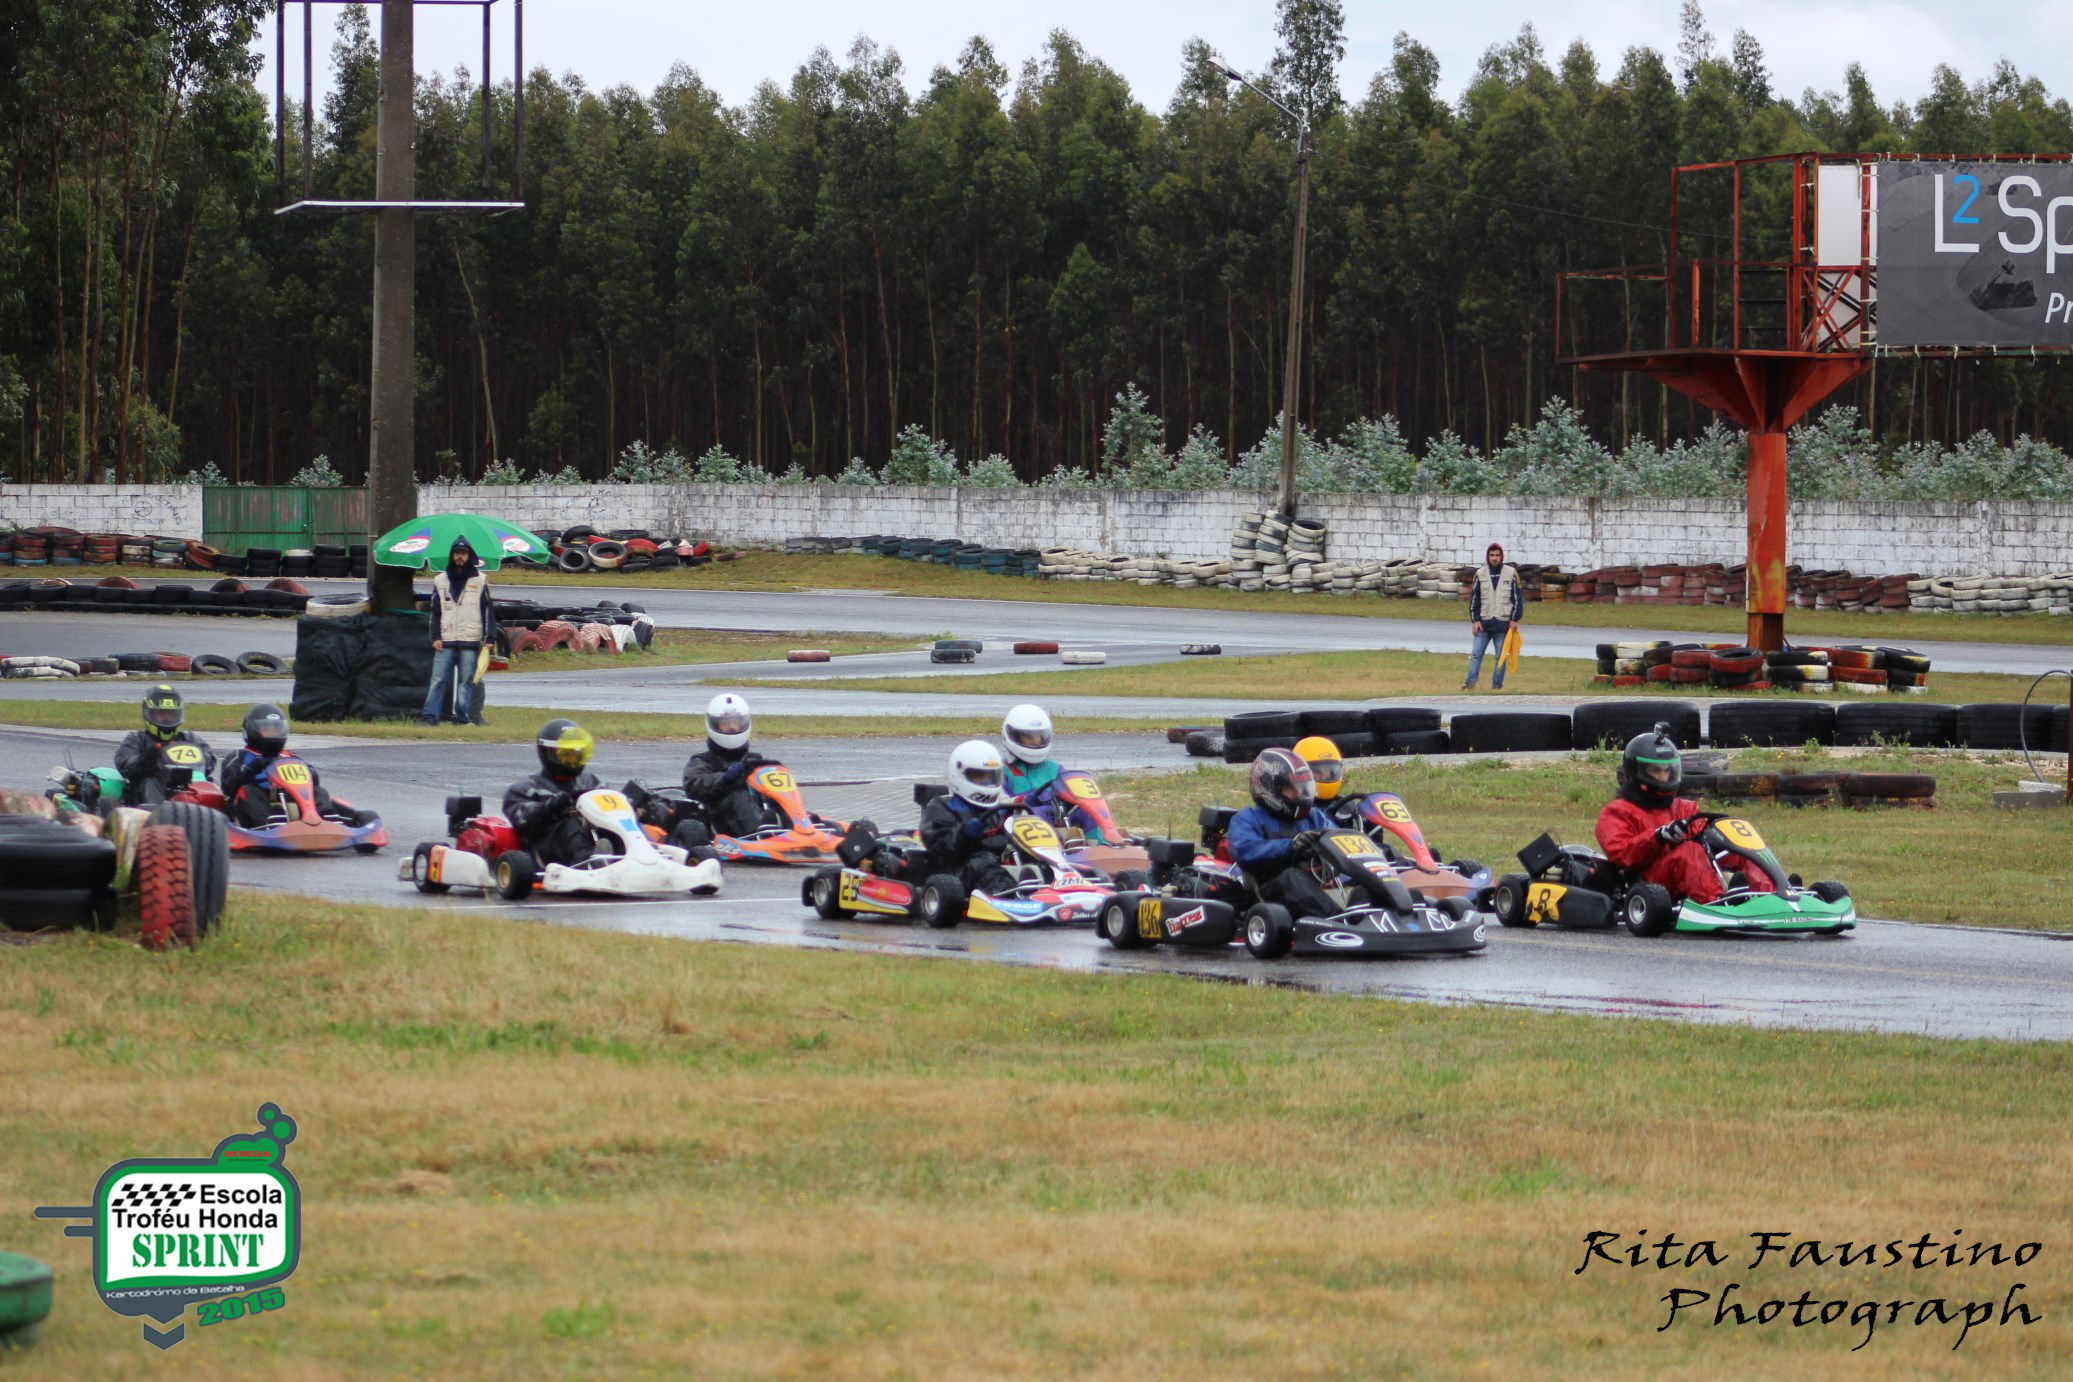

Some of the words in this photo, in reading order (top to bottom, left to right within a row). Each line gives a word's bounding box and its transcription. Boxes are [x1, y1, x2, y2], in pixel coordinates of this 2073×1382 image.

[171, 748, 197, 761] 74
[277, 764, 311, 784] 104
[766, 772, 793, 788] 67
[1015, 821, 1052, 842] 25
[1730, 821, 1752, 837] 8
[1335, 837, 1376, 855] 136
[1140, 902, 1160, 936] 136
